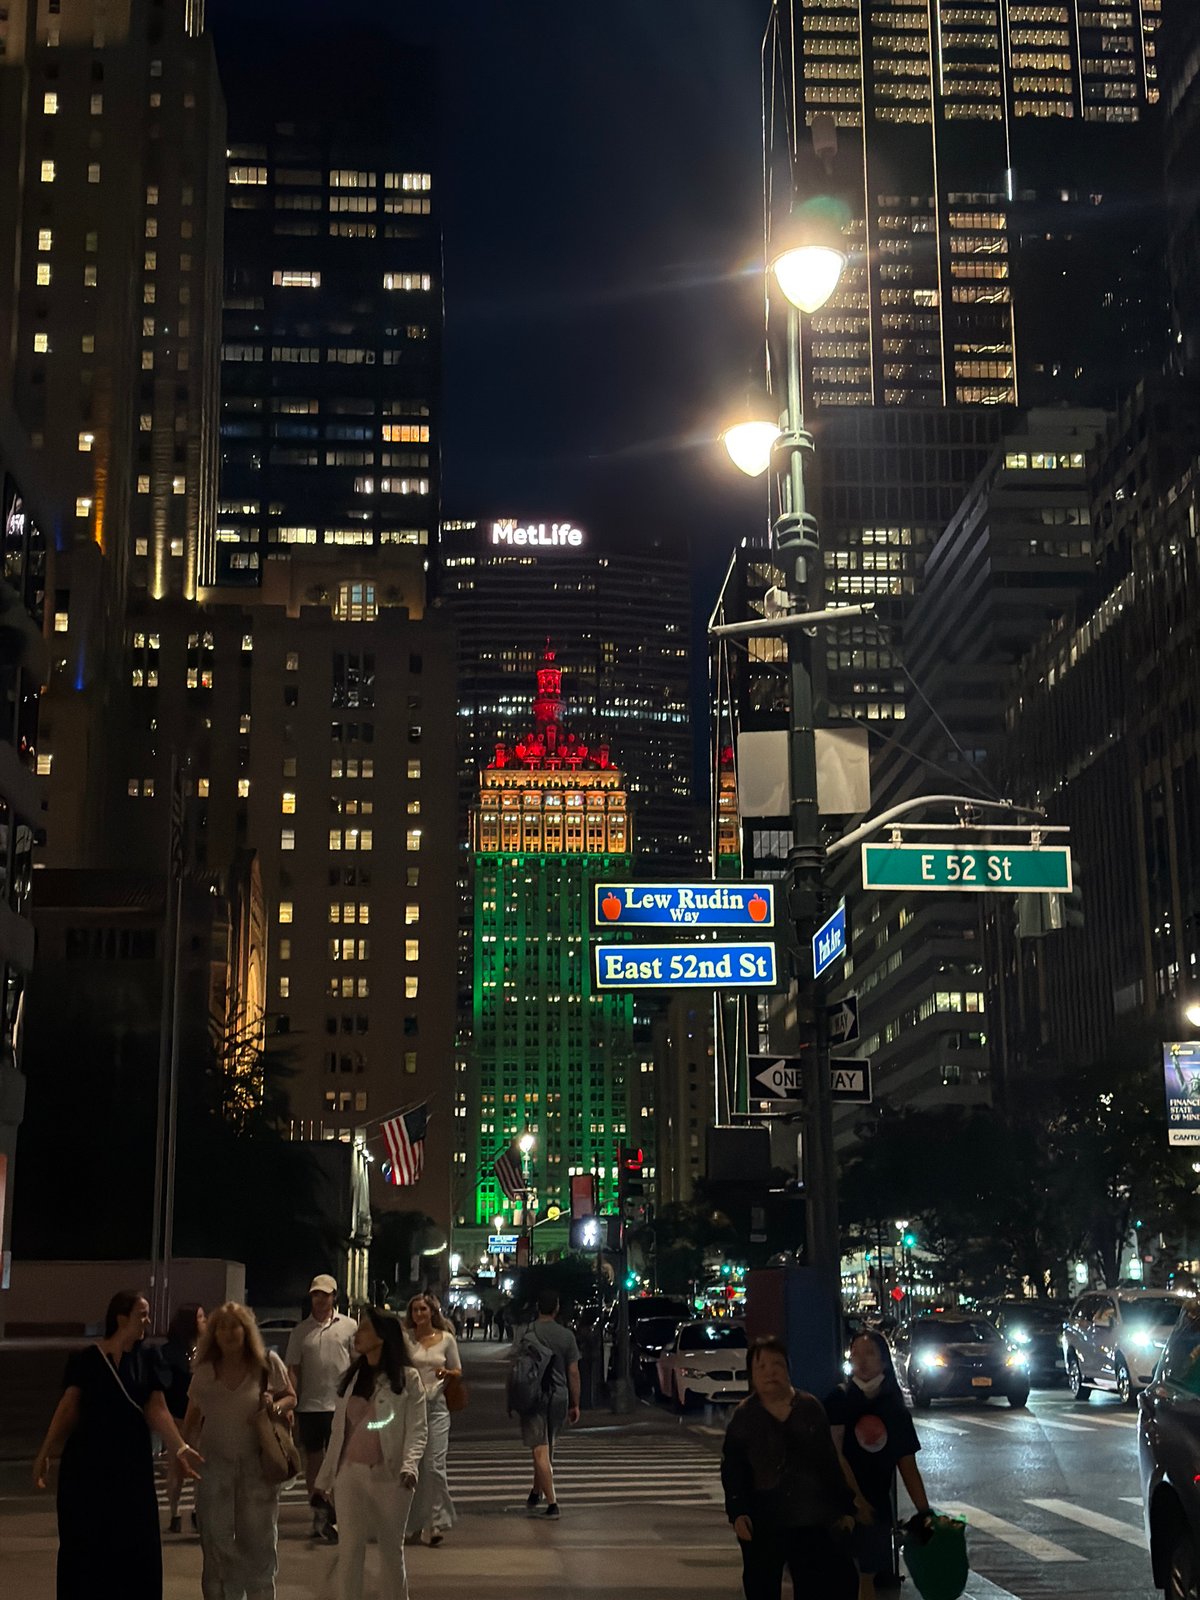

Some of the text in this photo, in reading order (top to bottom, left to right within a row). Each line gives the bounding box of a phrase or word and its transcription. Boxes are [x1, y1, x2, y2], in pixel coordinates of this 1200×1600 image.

[492, 523, 582, 545] MetLife
[921, 854, 1012, 881] E 52 St
[624, 888, 745, 910] Lew Rudin
[669, 908, 700, 924] Way
[604, 952, 768, 980] East 52nd St
[1170, 1106, 1193, 1114] STATE
[1170, 1113, 1181, 1121] OF
